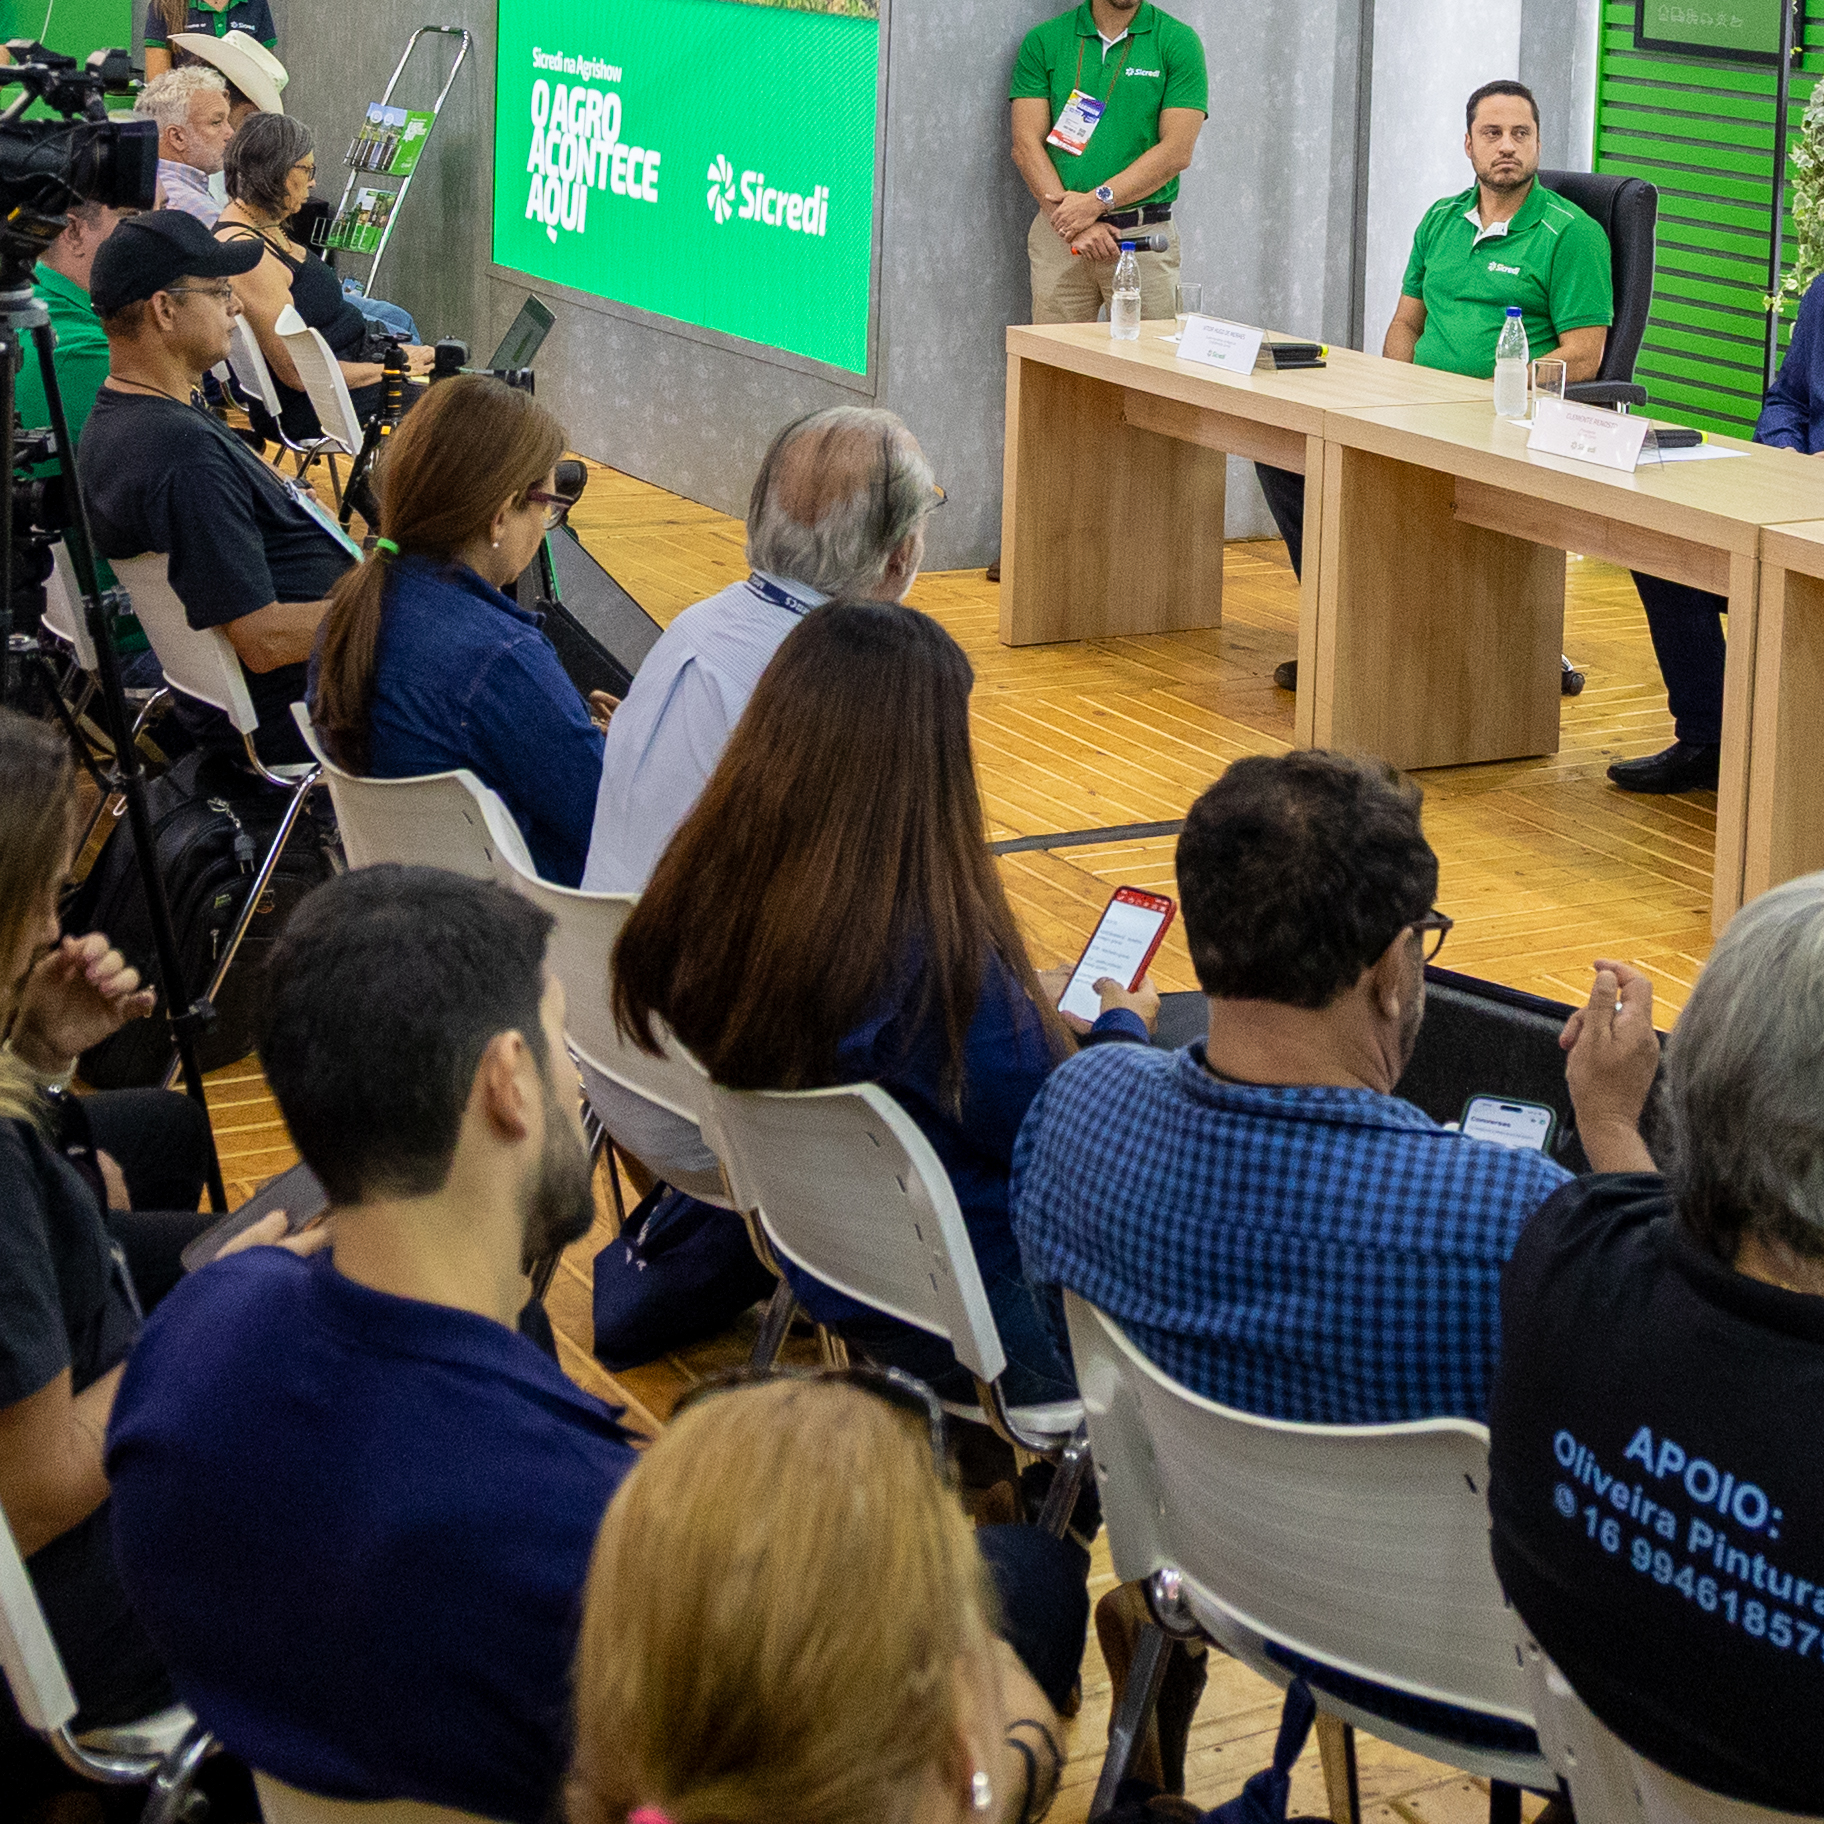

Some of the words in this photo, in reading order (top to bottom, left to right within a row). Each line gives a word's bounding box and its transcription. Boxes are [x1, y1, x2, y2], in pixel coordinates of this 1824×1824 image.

[532, 47, 563, 75] Sicredi
[563, 56, 576, 74] na
[575, 53, 622, 83] Agrishow
[1134, 68, 1160, 78] Sicredi
[530, 79, 551, 128] O
[549, 83, 622, 143] AGRO
[526, 125, 661, 203] ACONTECE
[525, 173, 588, 244] AQUI
[738, 170, 829, 237] Sicredi
[1496, 263, 1521, 275] Sicredi
[1552, 1428, 1679, 1542] Oliveira
[1622, 1426, 1784, 1539] APOIO:
[1581, 1503, 1622, 1554] 16
